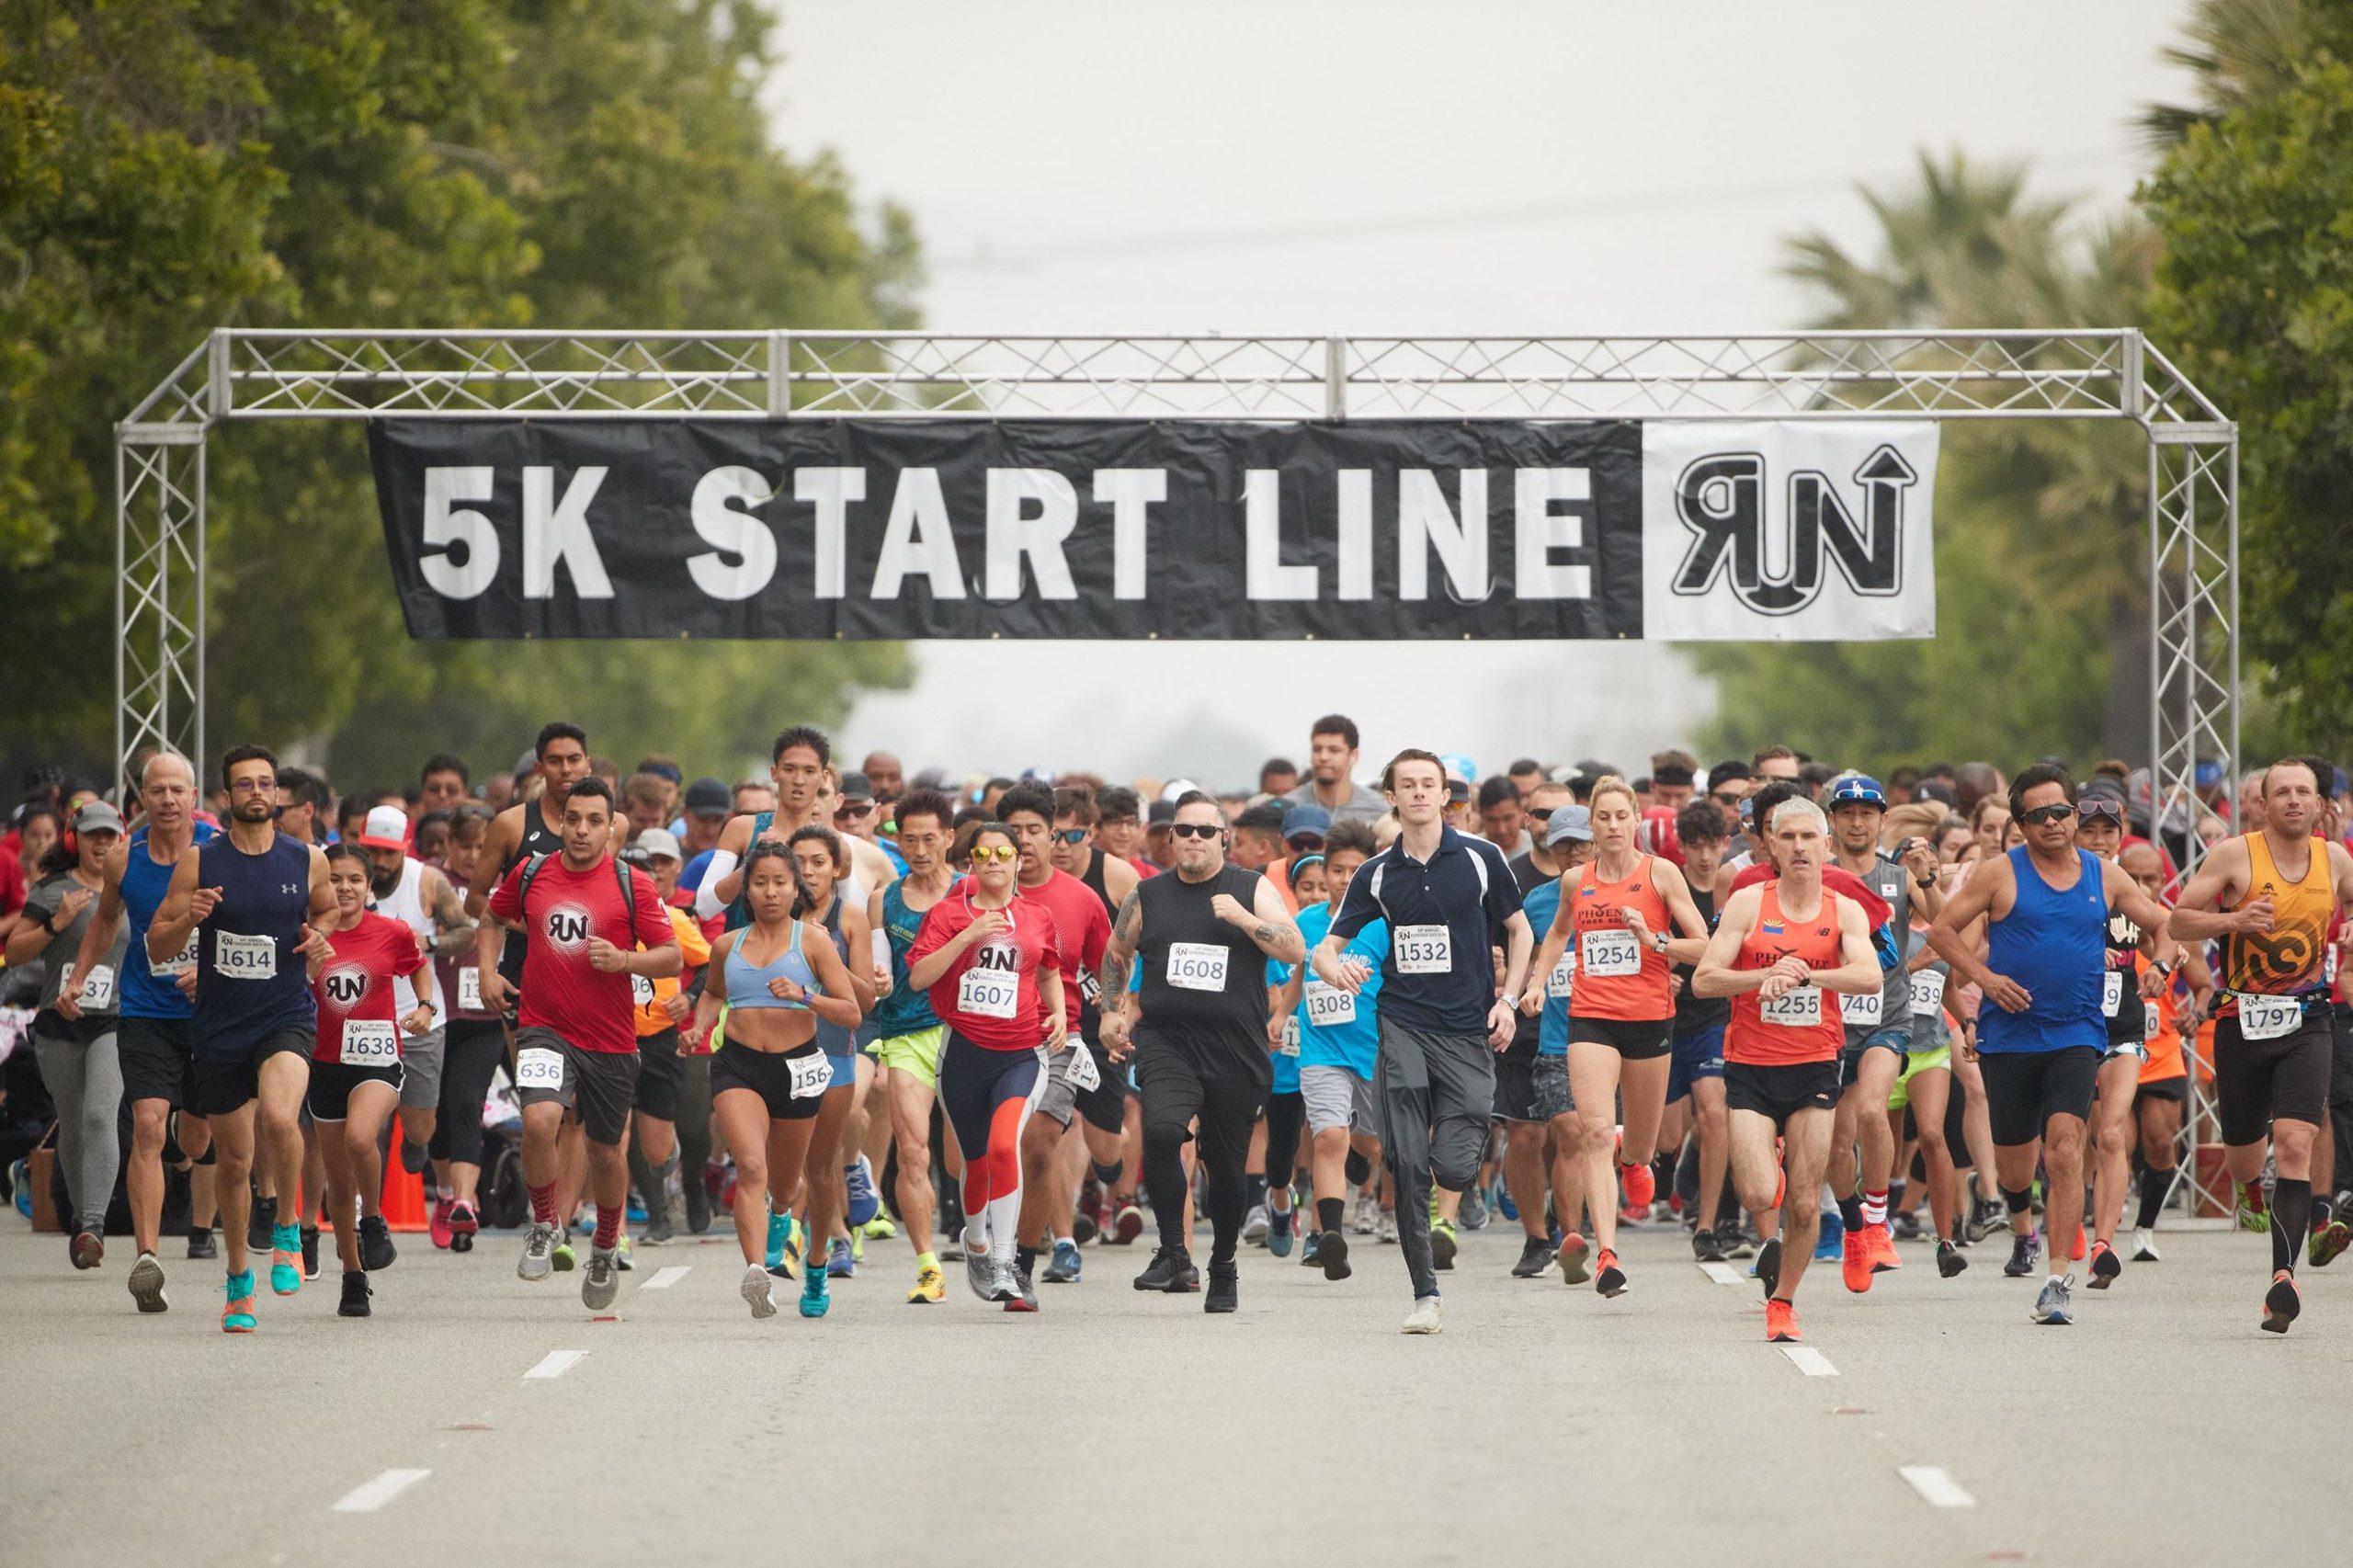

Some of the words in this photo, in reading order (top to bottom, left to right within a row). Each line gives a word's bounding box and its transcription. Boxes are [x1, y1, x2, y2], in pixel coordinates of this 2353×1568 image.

[418, 465, 616, 601] 5K
[687, 465, 1168, 601] START
[1246, 467, 1590, 601] LINE
[1578, 908, 1622, 919] PHOEN
[222, 949, 271, 968] 1614
[1399, 942, 1447, 961] 1532
[1587, 946, 1637, 965] 1254
[1172, 960, 1223, 979] 1608
[1550, 968, 1574, 986] 156
[85, 981, 110, 998] 37
[963, 983, 1015, 1006] 1607
[1910, 984, 1940, 1005] 839
[1309, 994, 1351, 1015] 1308
[1767, 995, 1818, 1014] 1255
[1842, 994, 1879, 1014] 740
[2245, 1007, 2298, 1028] 1797
[347, 1037, 395, 1055] 1638
[520, 1062, 560, 1079] 636
[796, 1067, 830, 1090] 156
